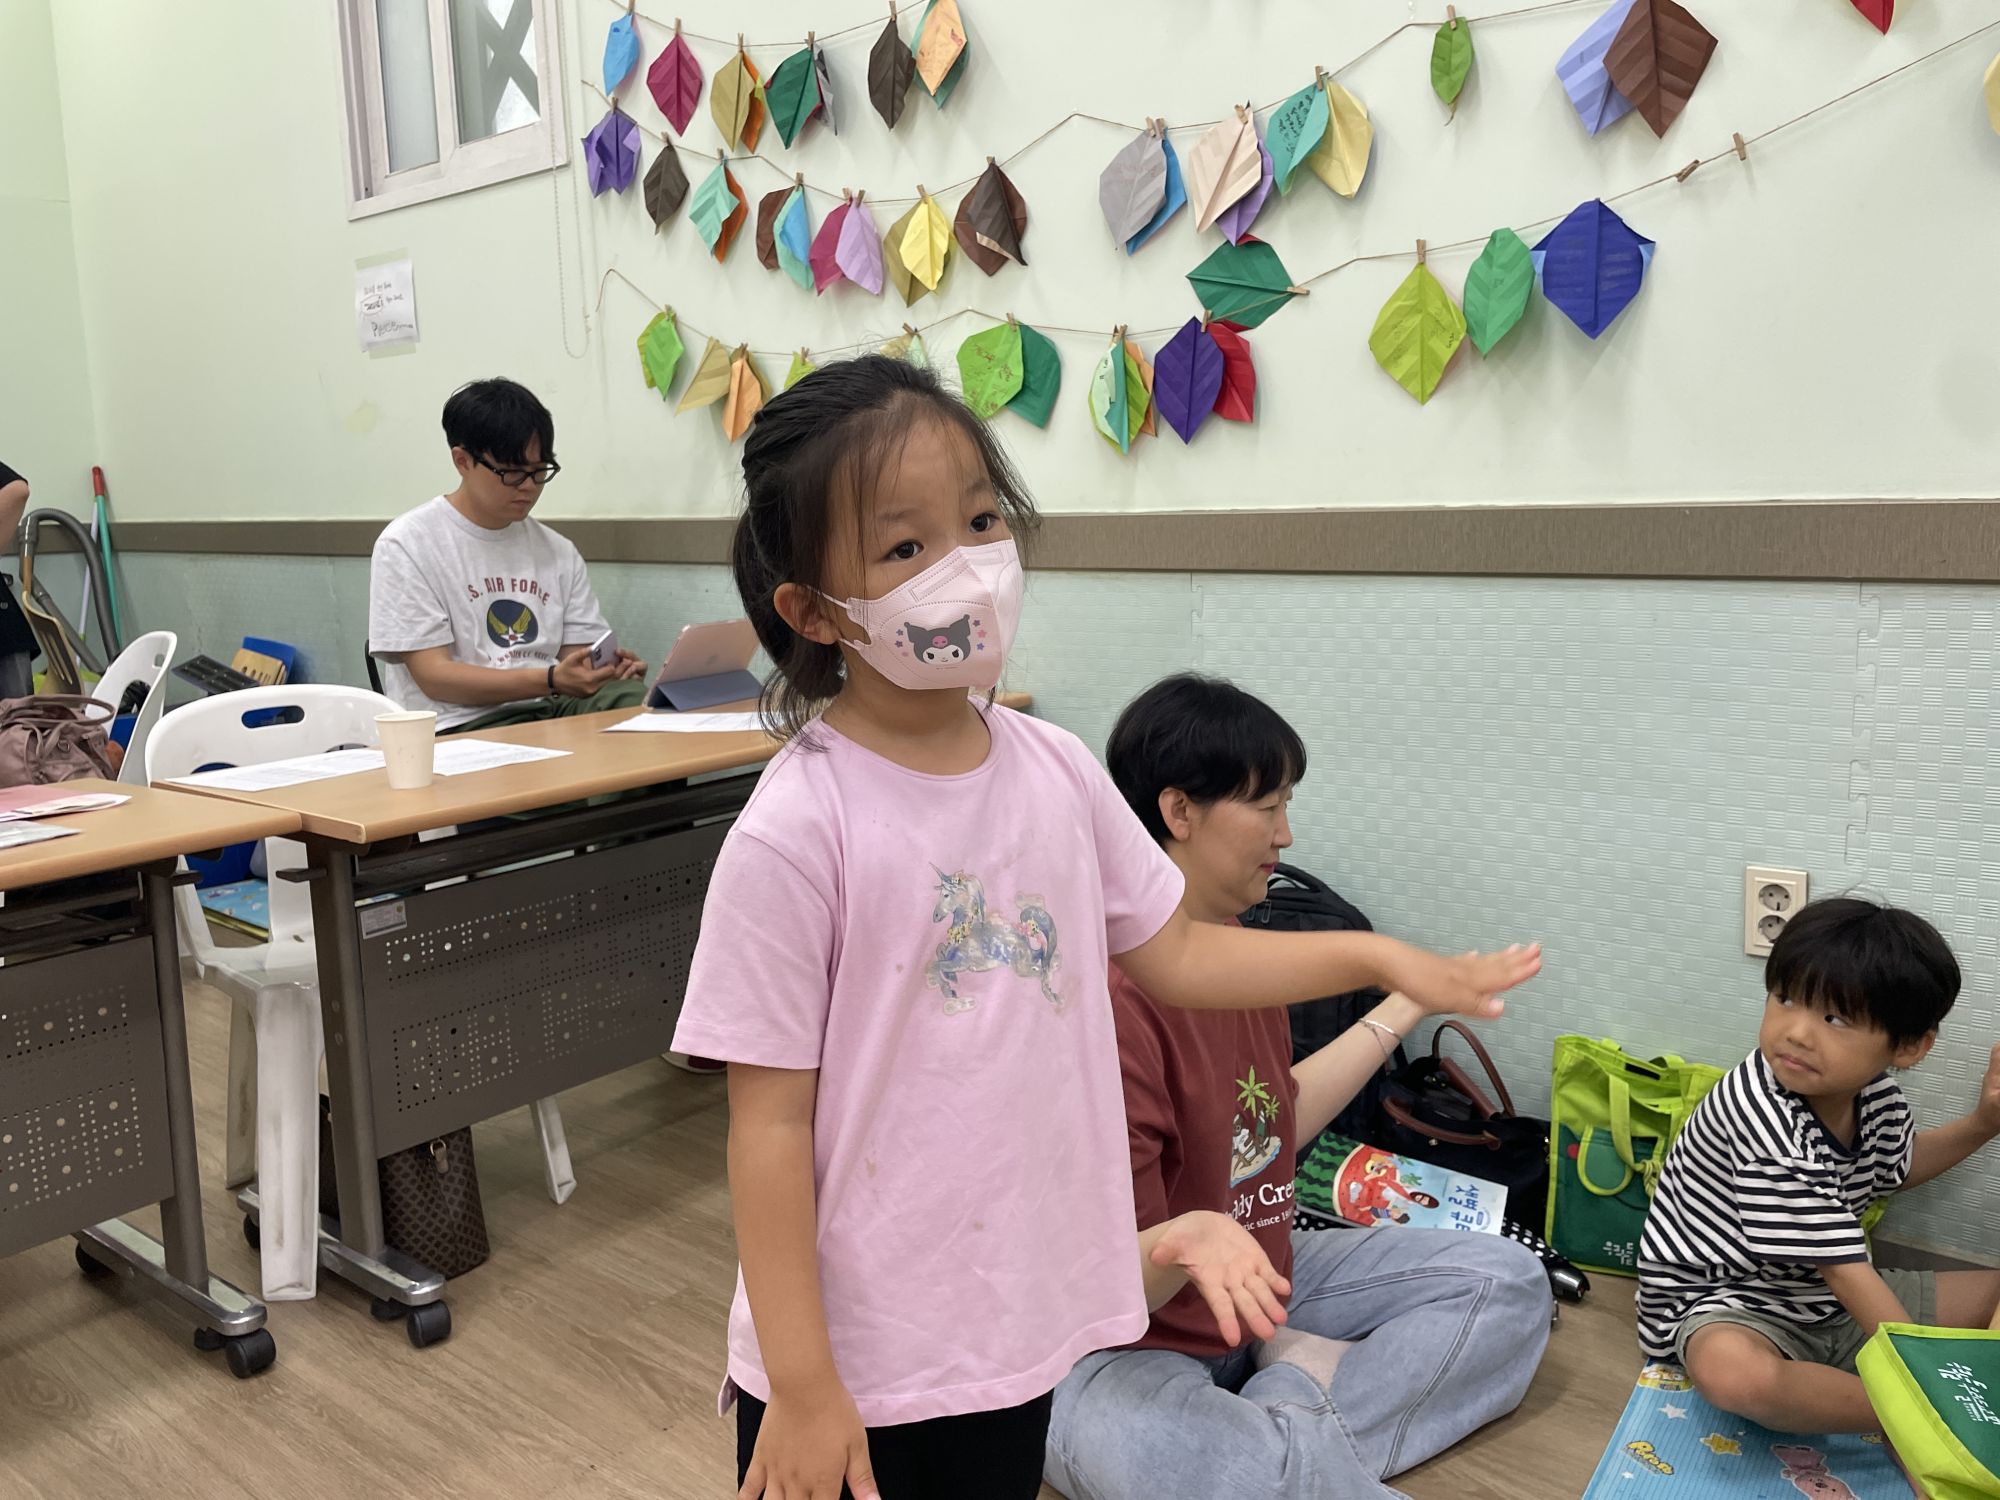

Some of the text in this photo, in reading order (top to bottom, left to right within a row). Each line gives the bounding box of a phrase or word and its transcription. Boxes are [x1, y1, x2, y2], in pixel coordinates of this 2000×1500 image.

[484, 577, 505, 593] AIR
[1258, 1180, 1295, 1206] Cre
[1256, 1215, 1281, 1228] since
